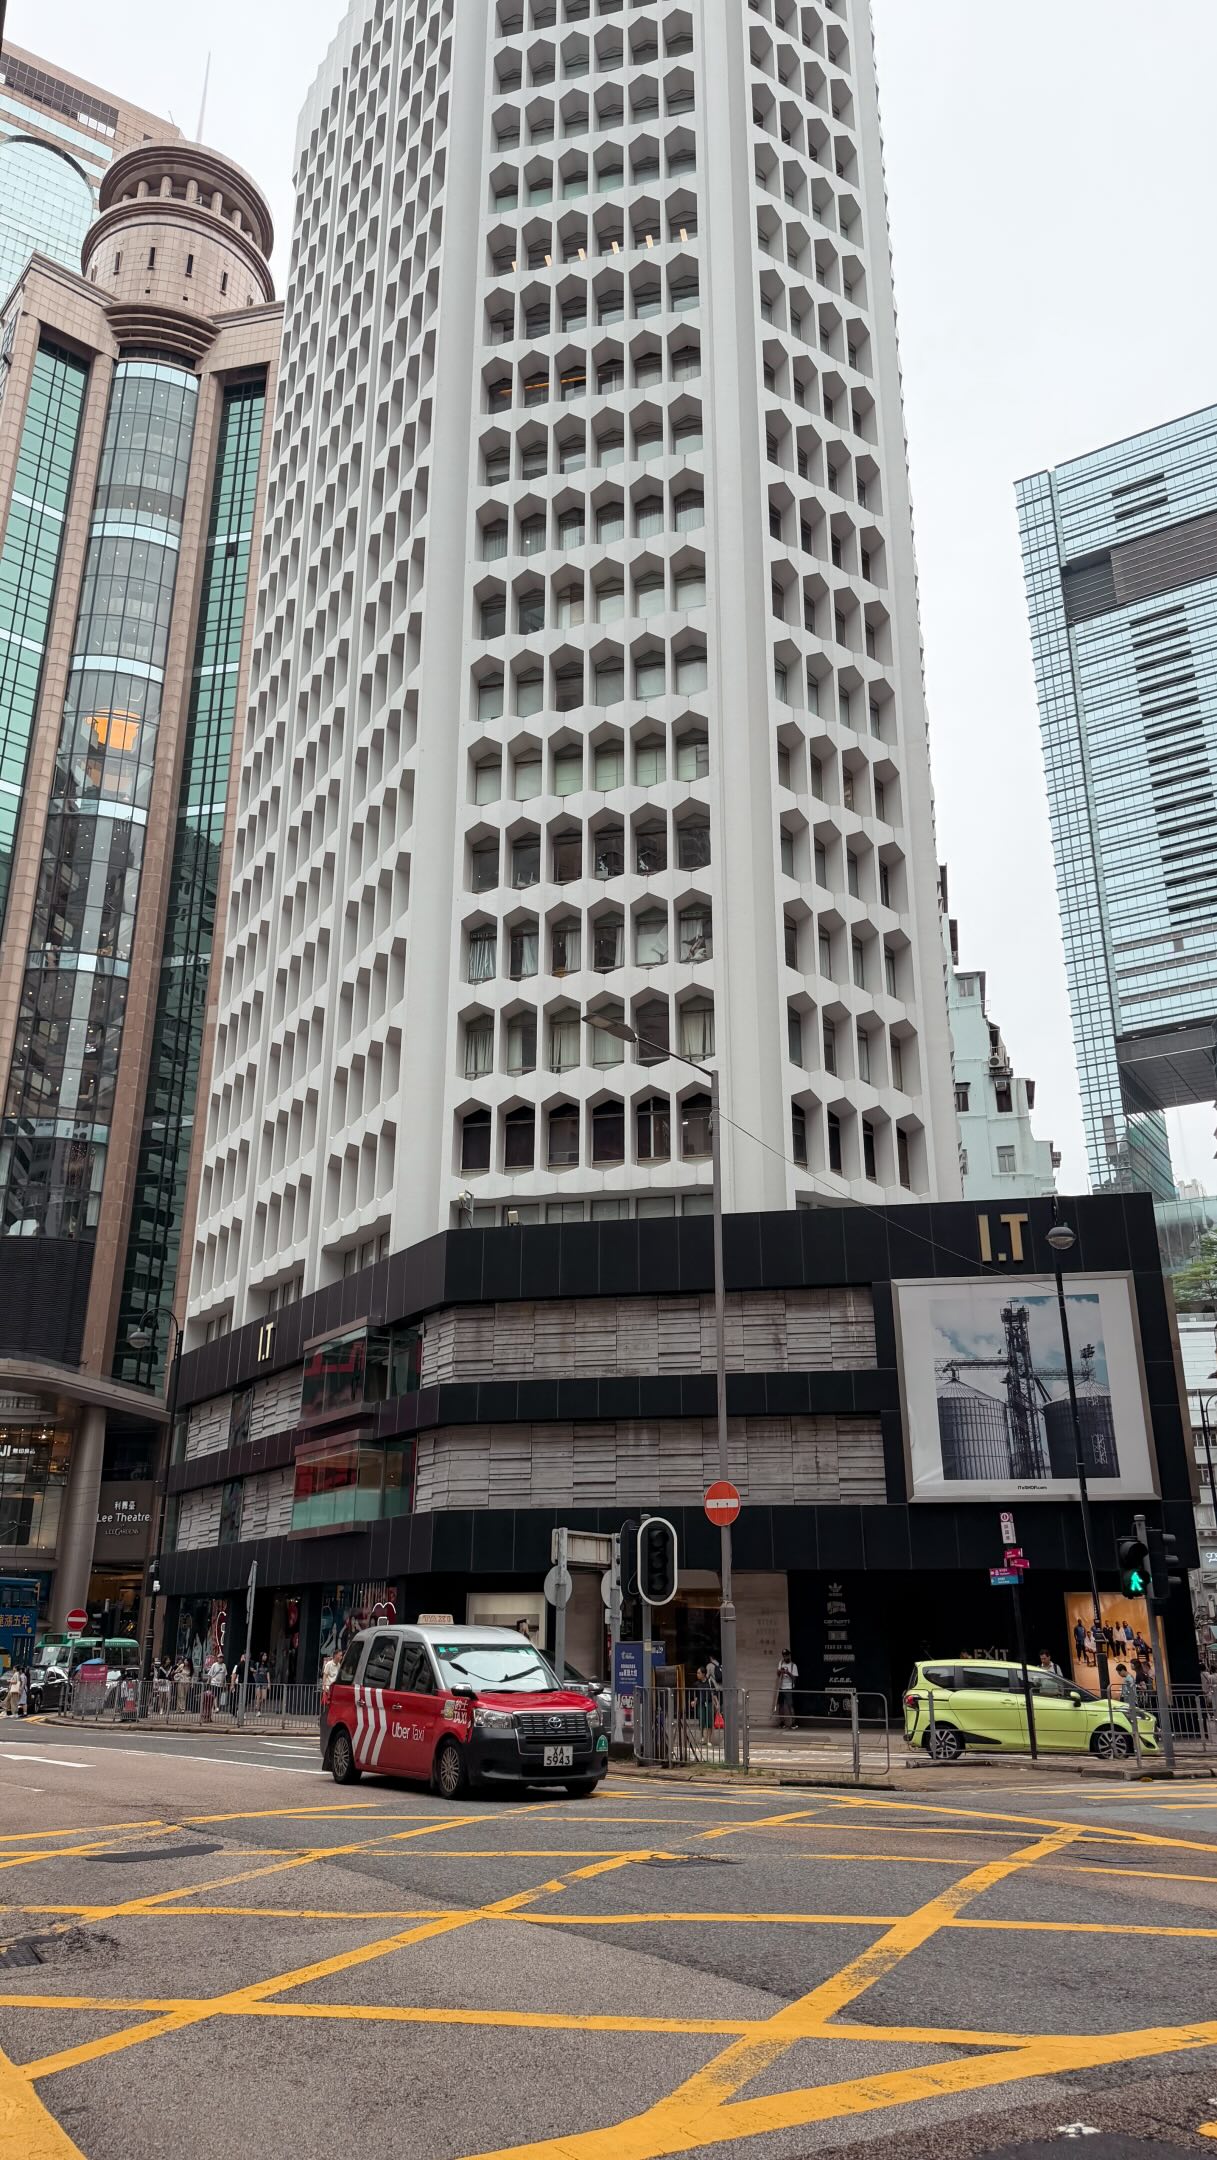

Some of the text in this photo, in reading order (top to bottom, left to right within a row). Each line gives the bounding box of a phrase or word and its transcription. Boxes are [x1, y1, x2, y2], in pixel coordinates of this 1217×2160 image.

[978, 1213, 1028, 1261] I.T
[258, 1322, 273, 1362] I.T
[0, 1444, 12, 1457] JI
[96, 1512, 150, 1523] Lee Theatre
[453, 1711, 468, 1725] TAXI
[391, 1722, 426, 1741] Uber Taxi
[553, 1746, 565, 1755] XA
[546, 1755, 570, 1765] 5943
